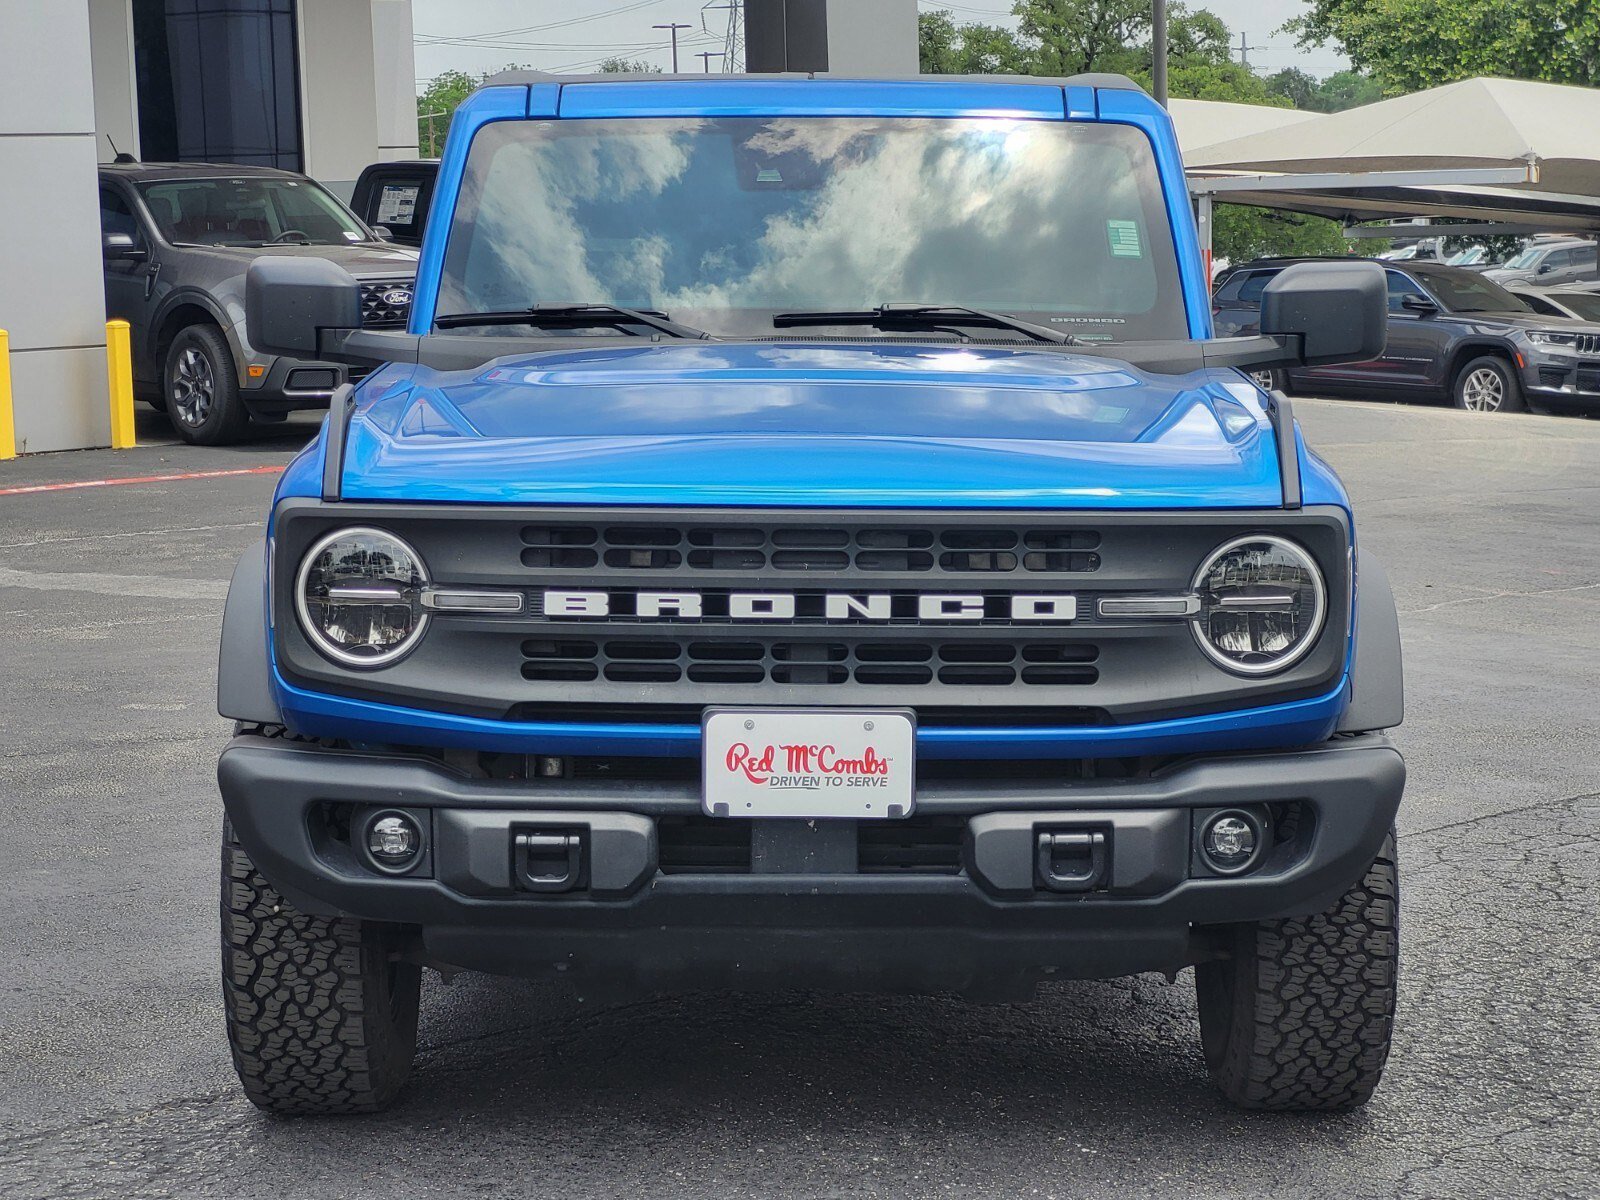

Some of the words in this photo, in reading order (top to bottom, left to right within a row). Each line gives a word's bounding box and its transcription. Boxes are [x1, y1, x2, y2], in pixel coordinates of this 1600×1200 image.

[543, 591, 1077, 620] BRONCO
[726, 743, 774, 784] Red
[779, 744, 887, 774] McCombs
[769, 776, 820, 787] DRIVEN
[825, 776, 843, 787] TO
[846, 777, 888, 787] SERVE
